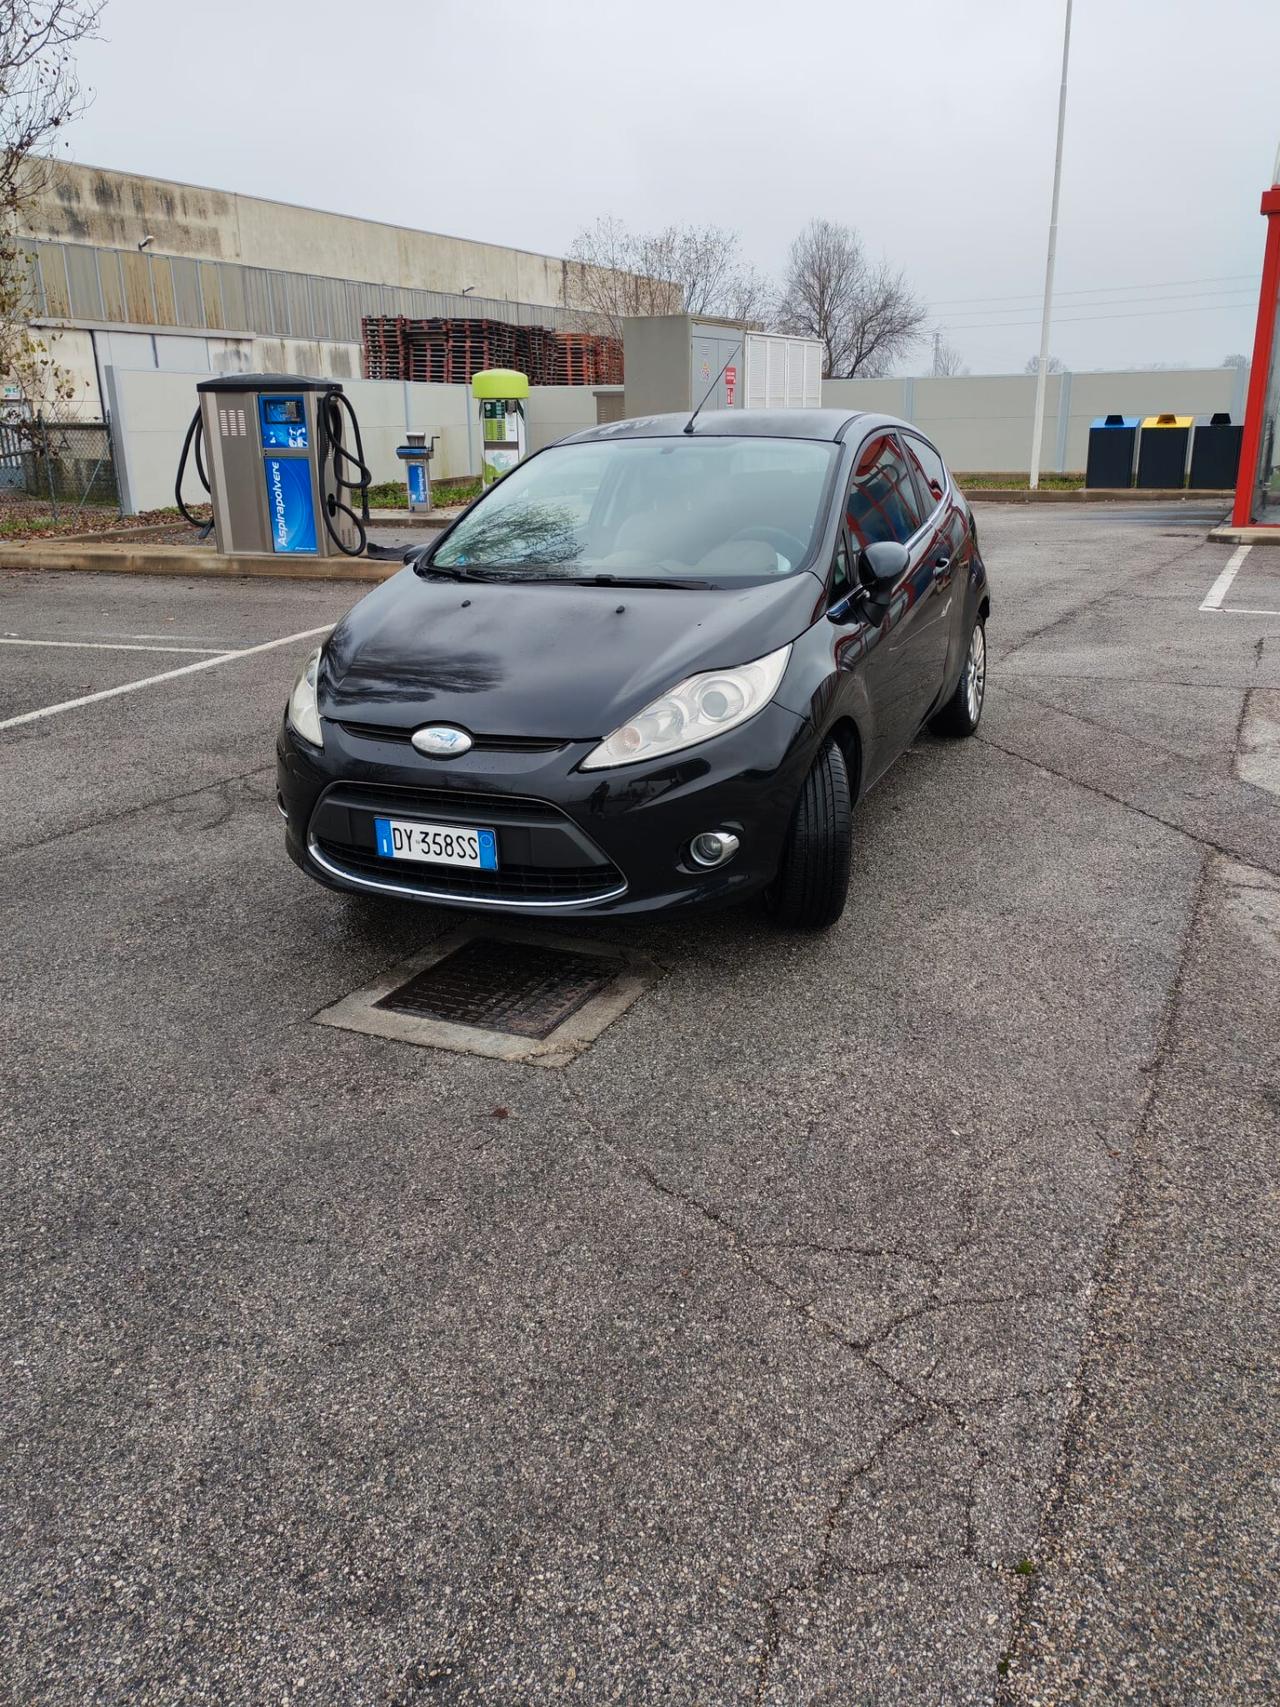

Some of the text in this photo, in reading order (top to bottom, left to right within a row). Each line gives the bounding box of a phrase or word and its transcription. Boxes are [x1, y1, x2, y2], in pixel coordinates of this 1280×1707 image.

[271, 461, 288, 547] Aspirapolvere
[392, 827, 478, 860] DY 358SS
